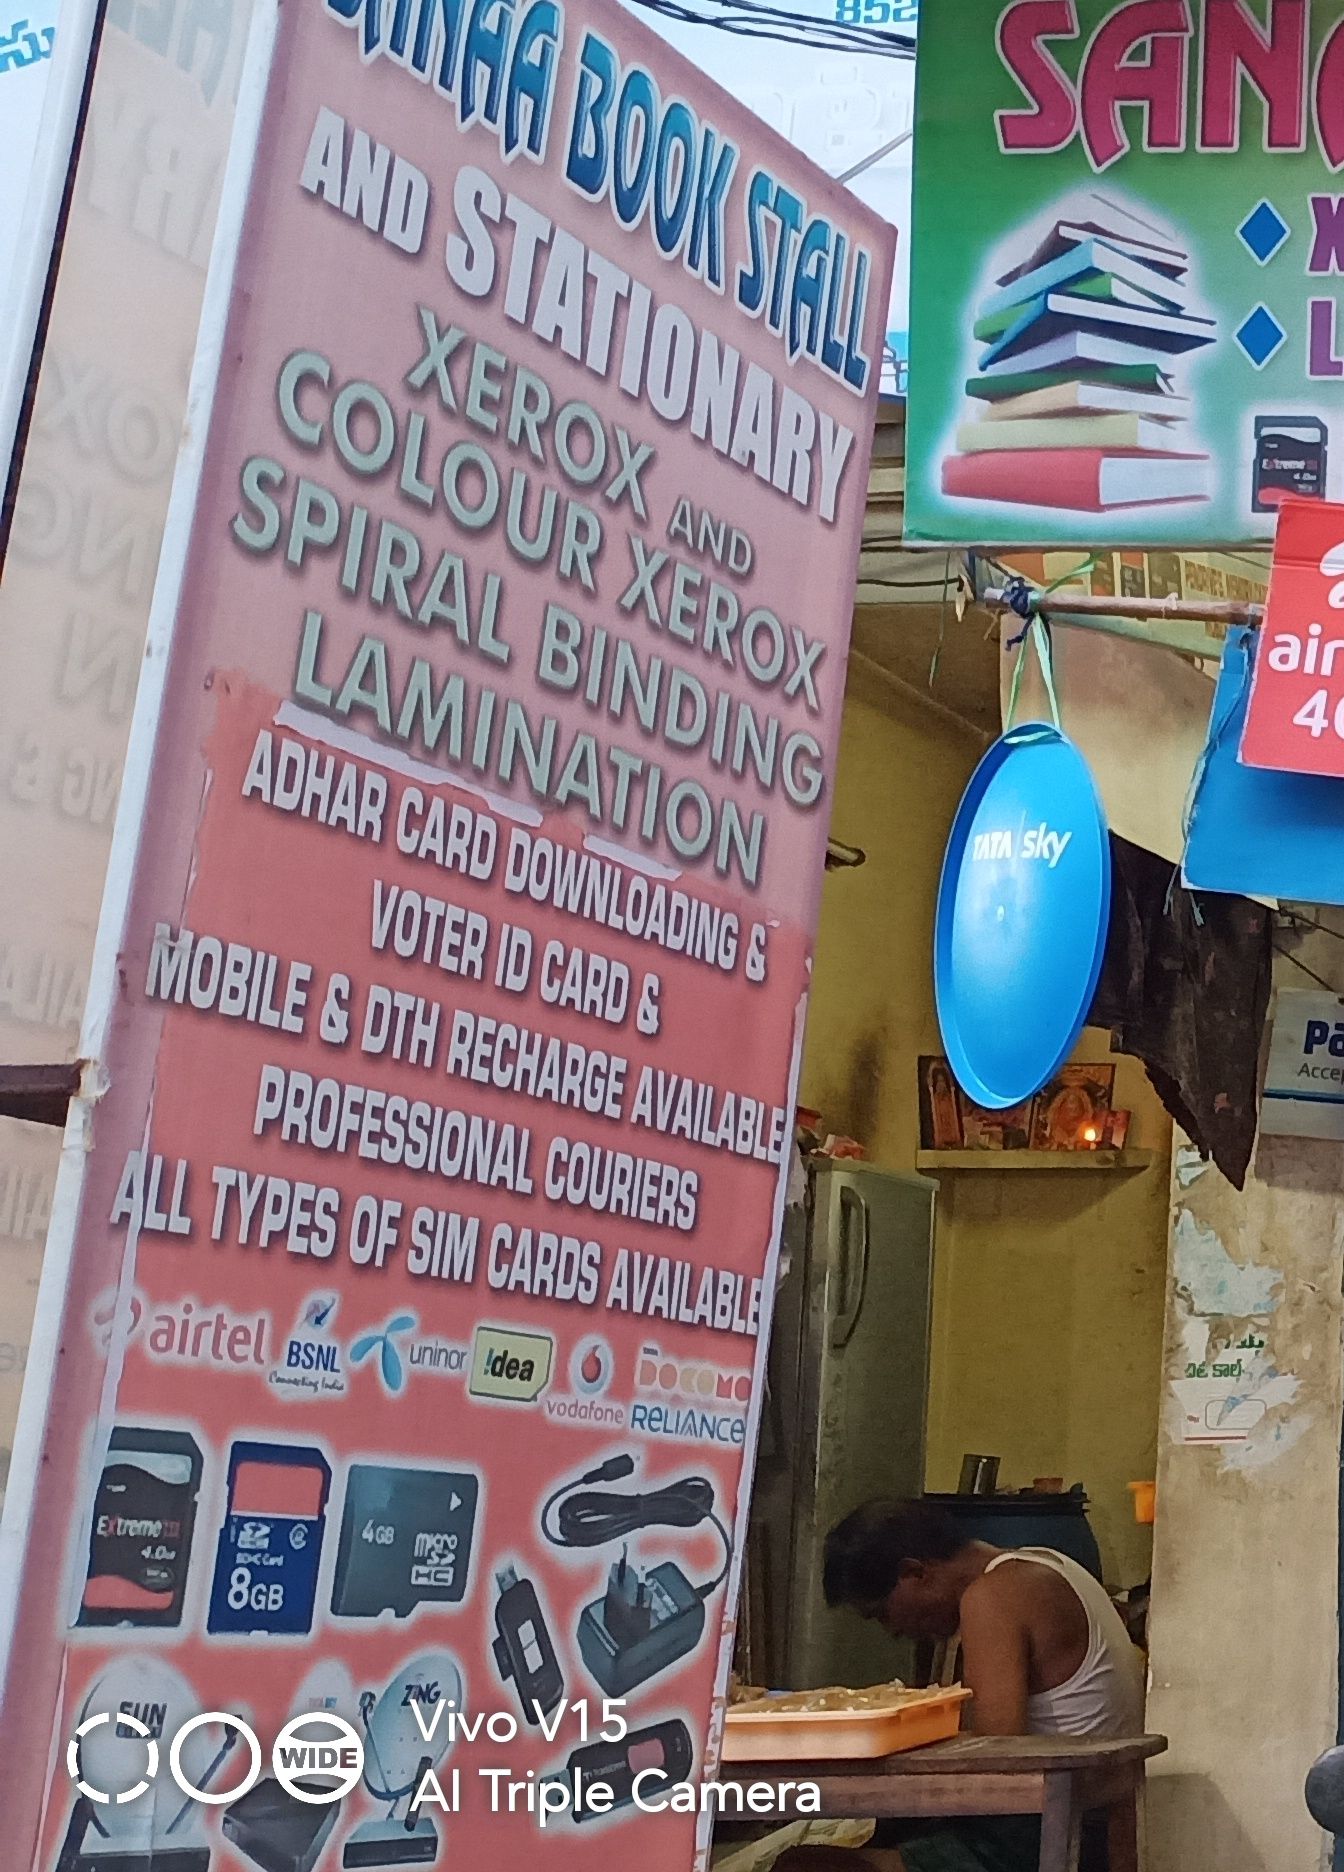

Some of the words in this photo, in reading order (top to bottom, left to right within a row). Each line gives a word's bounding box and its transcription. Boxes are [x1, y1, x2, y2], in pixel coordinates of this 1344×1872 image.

[327, 0, 562, 162] NAA
[566, 36, 738, 292] BOOK
[740, 170, 870, 395] STALL
[301, 105, 429, 255] AND
[446, 165, 855, 524] STATIONARY
[408, 306, 655, 520] XEROX
[670, 499, 752, 576] AND
[280, 352, 601, 588] COLOUR
[621, 537, 825, 708] XEROX
[233, 459, 510, 663] SPIRAL
[539, 604, 824, 805] BINDING
[296, 611, 766, 886] LAMINATION
[242, 730, 388, 844] ADHAR
[397, 786, 496, 880] CARD
[504, 828, 739, 971] DOWNLOADING
[744, 924, 767, 982] &
[972, 831, 1013, 862] TATA
[1021, 823, 1072, 868] sky
[144, 923, 312, 1034] MOBILE
[320, 973, 351, 1045] &
[361, 985, 441, 1068] DTH
[447, 1012, 628, 1120] RECHARGE
[631, 1066, 786, 1164] AVAILABLE
[371, 879, 487, 979] VOTER
[496, 923, 531, 993] ID
[540, 939, 628, 1026] CARD
[636, 973, 660, 1036] &
[252, 1064, 533, 1195] PROFESSIONAL
[545, 1136, 698, 1231] COURIERS
[109, 1150, 192, 1236] ALL
[211, 1166, 340, 1259] TYPES
[350, 1195, 402, 1268] OF
[408, 1207, 478, 1284] SIM
[487, 1223, 600, 1306] CARDS
[606, 1251, 762, 1338] AVAILABLE
[150, 1303, 266, 1365] airtel
[287, 1341, 341, 1373] BSNL
[409, 1341, 468, 1370] uninor
[547, 1400, 625, 1424] vodafone
[228, 1567, 283, 1610] 8GB
[118, 1701, 168, 1728] SUN
